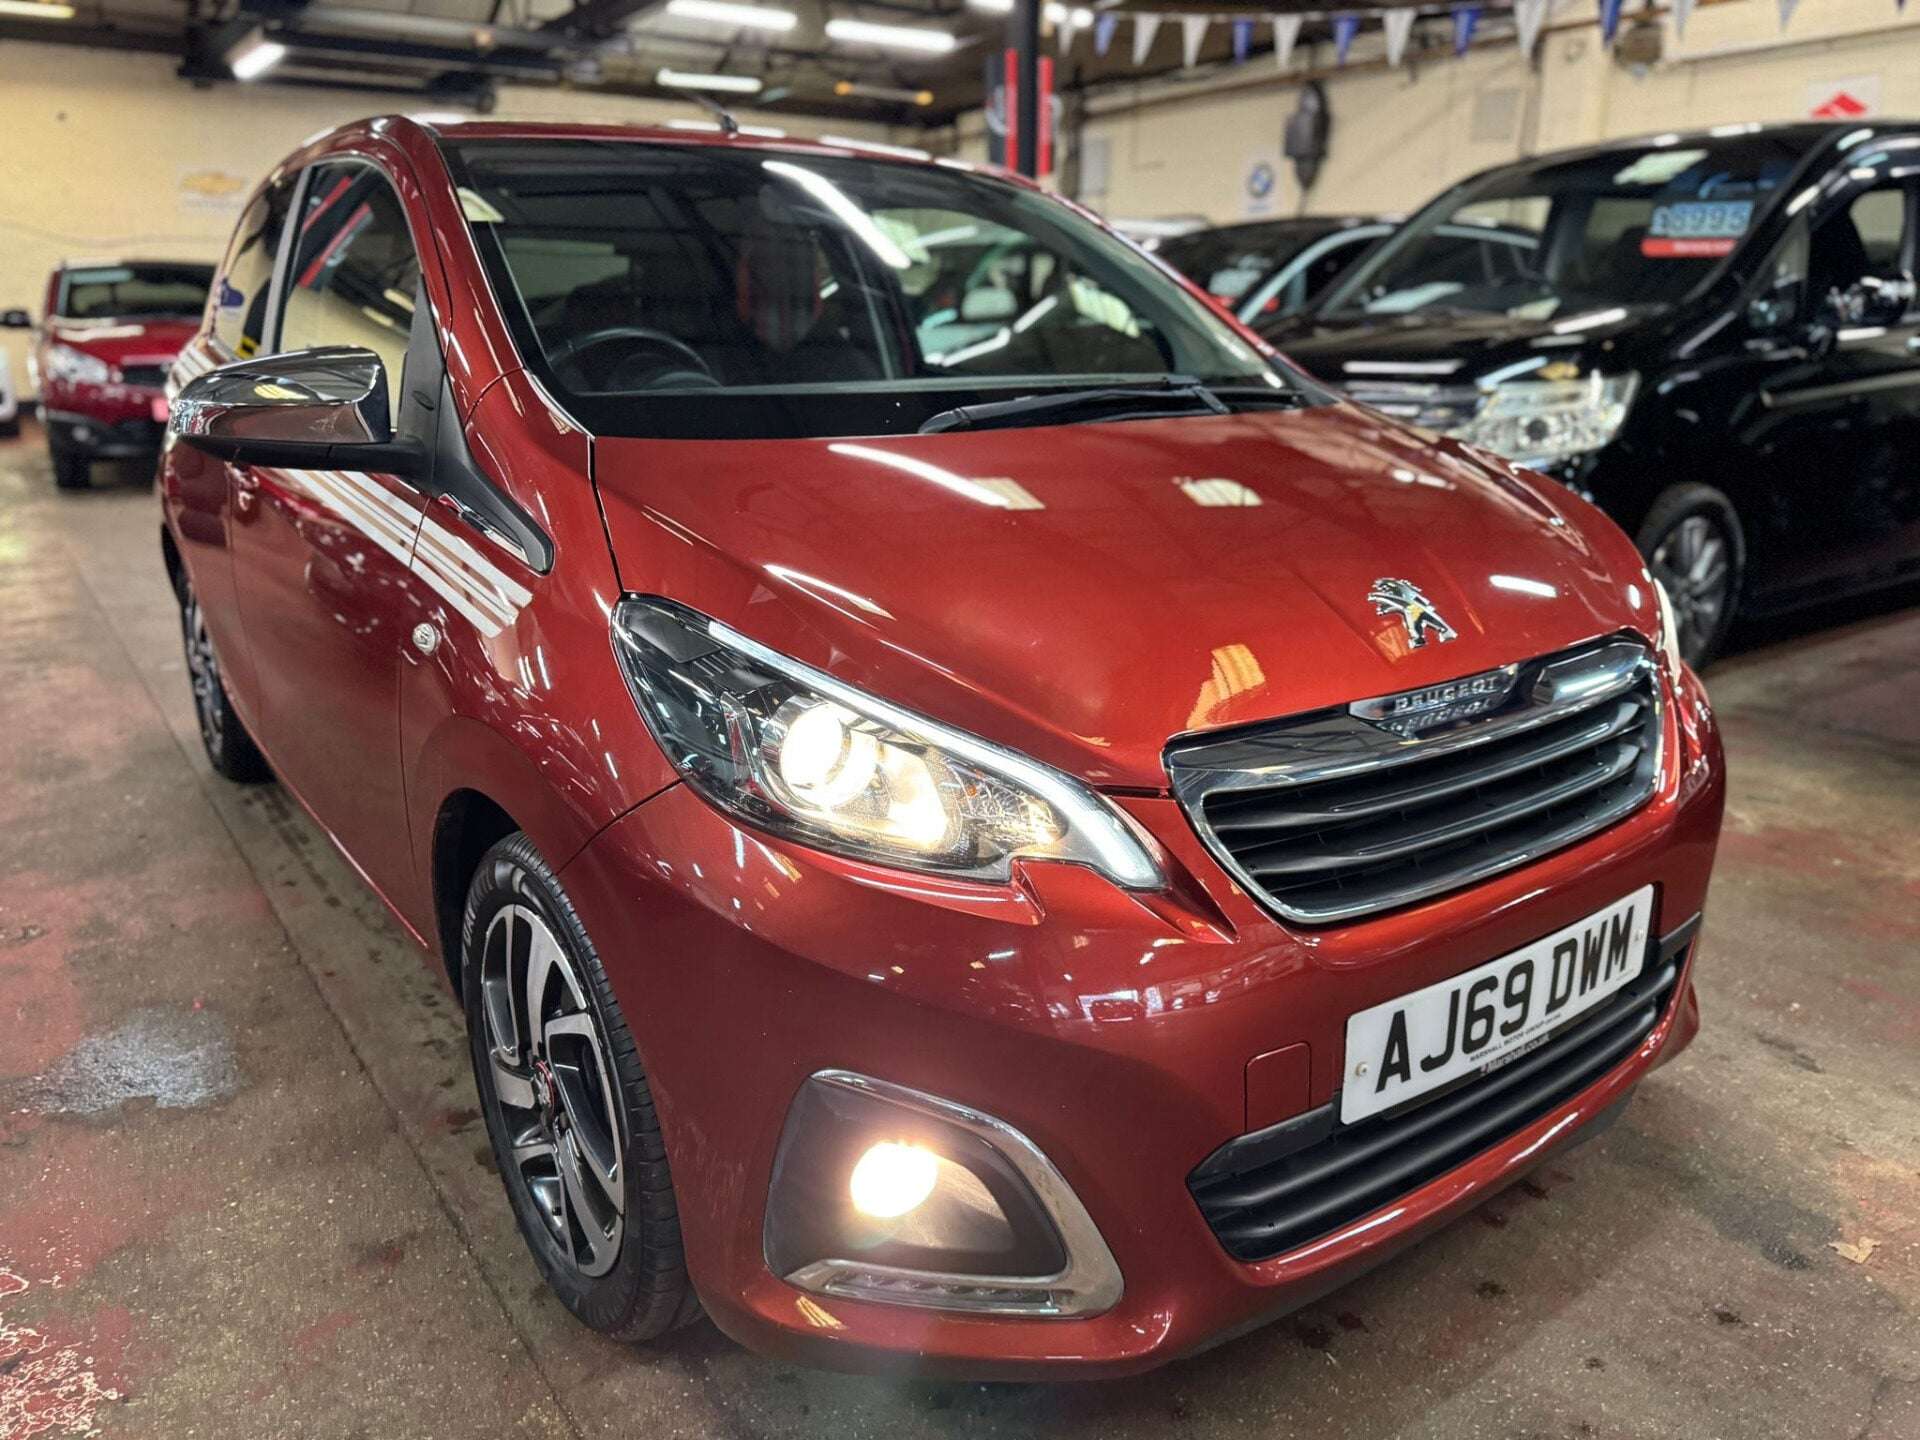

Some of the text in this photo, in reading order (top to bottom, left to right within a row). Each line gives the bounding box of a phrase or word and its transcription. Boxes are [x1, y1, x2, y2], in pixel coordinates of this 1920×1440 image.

[1394, 675, 1498, 712] PEUGEOT
[1375, 905, 1634, 1094] AJ69 DWM
